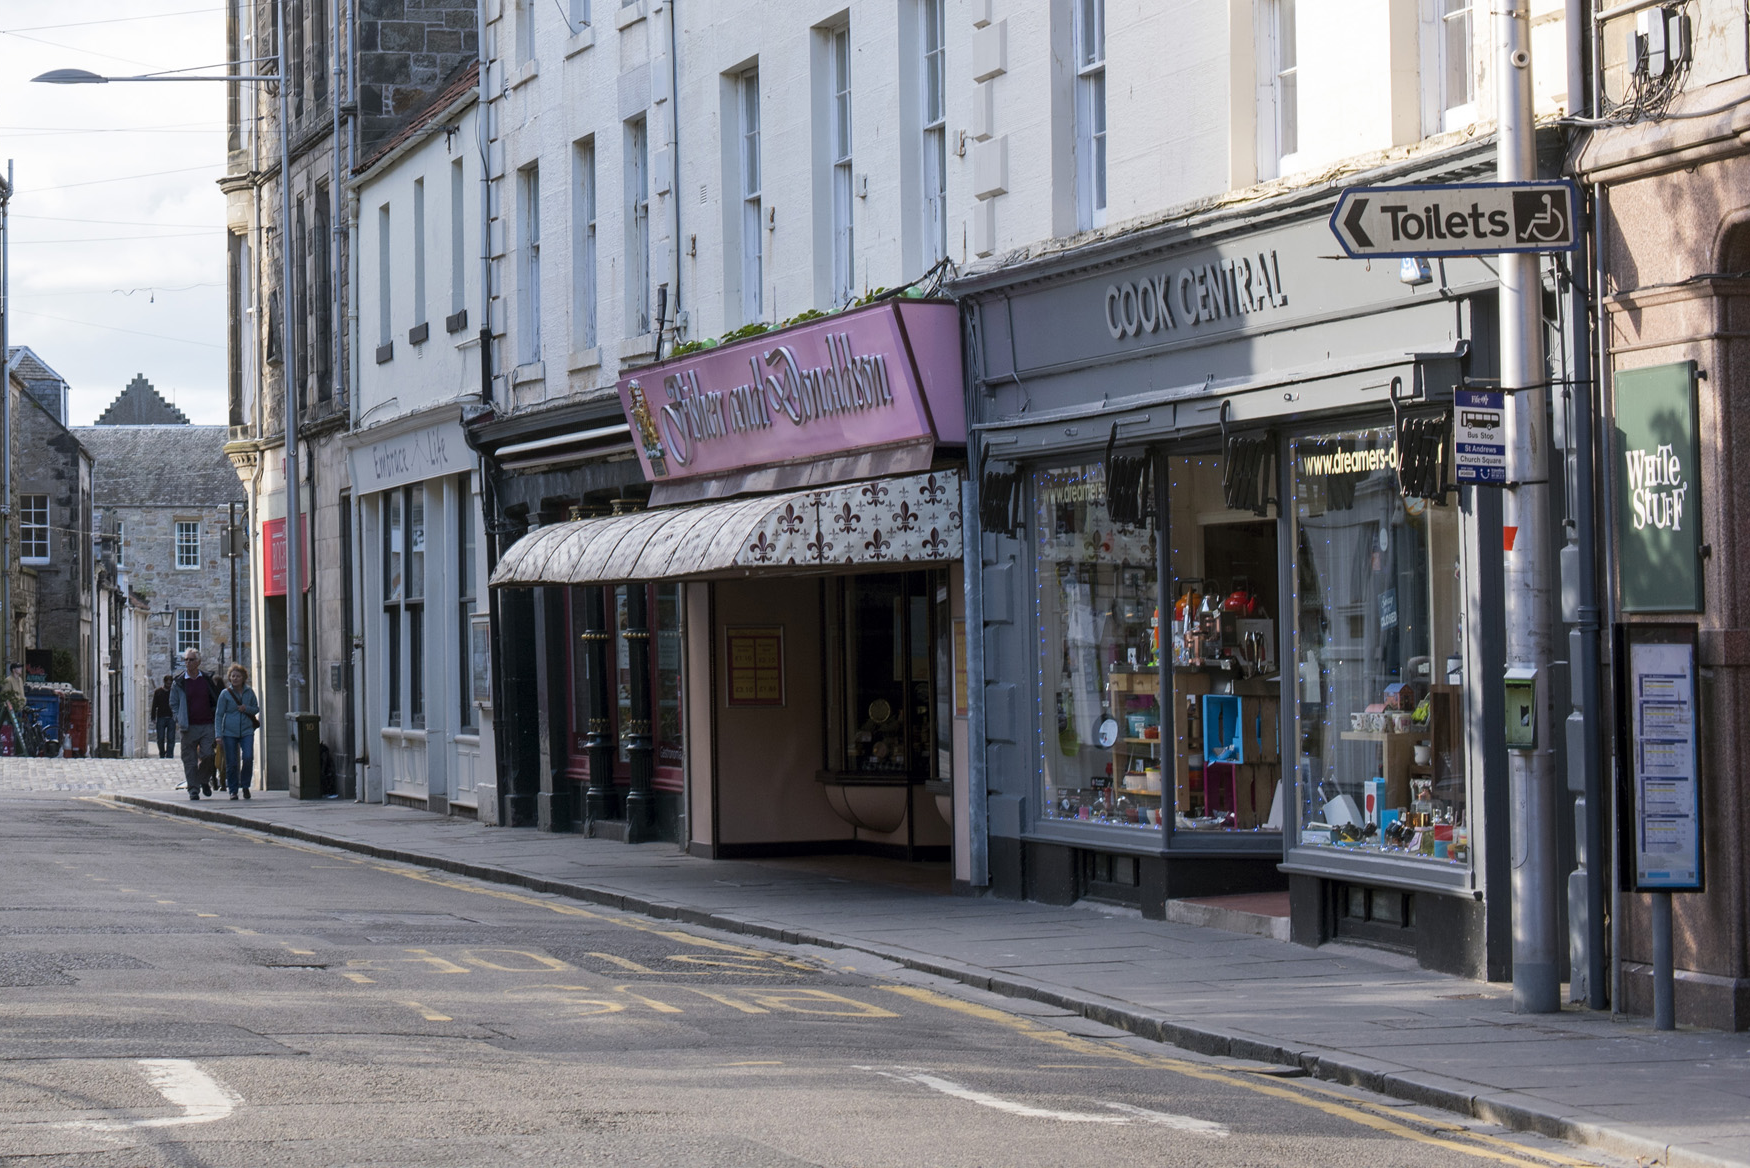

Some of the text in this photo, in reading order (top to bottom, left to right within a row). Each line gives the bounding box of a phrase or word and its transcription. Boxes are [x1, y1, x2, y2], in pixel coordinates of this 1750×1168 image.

[1380, 202, 1510, 241] Toilets
[1105, 247, 1286, 340] COOK CENTRAL
[660, 331, 894, 467] Fisher and Donaldson
[372, 425, 449, 480] Embrace Life
[1464, 444, 1497, 454] St Andrews
[1480, 432, 1495, 441] Stop
[1460, 455, 1502, 465] Church Square
